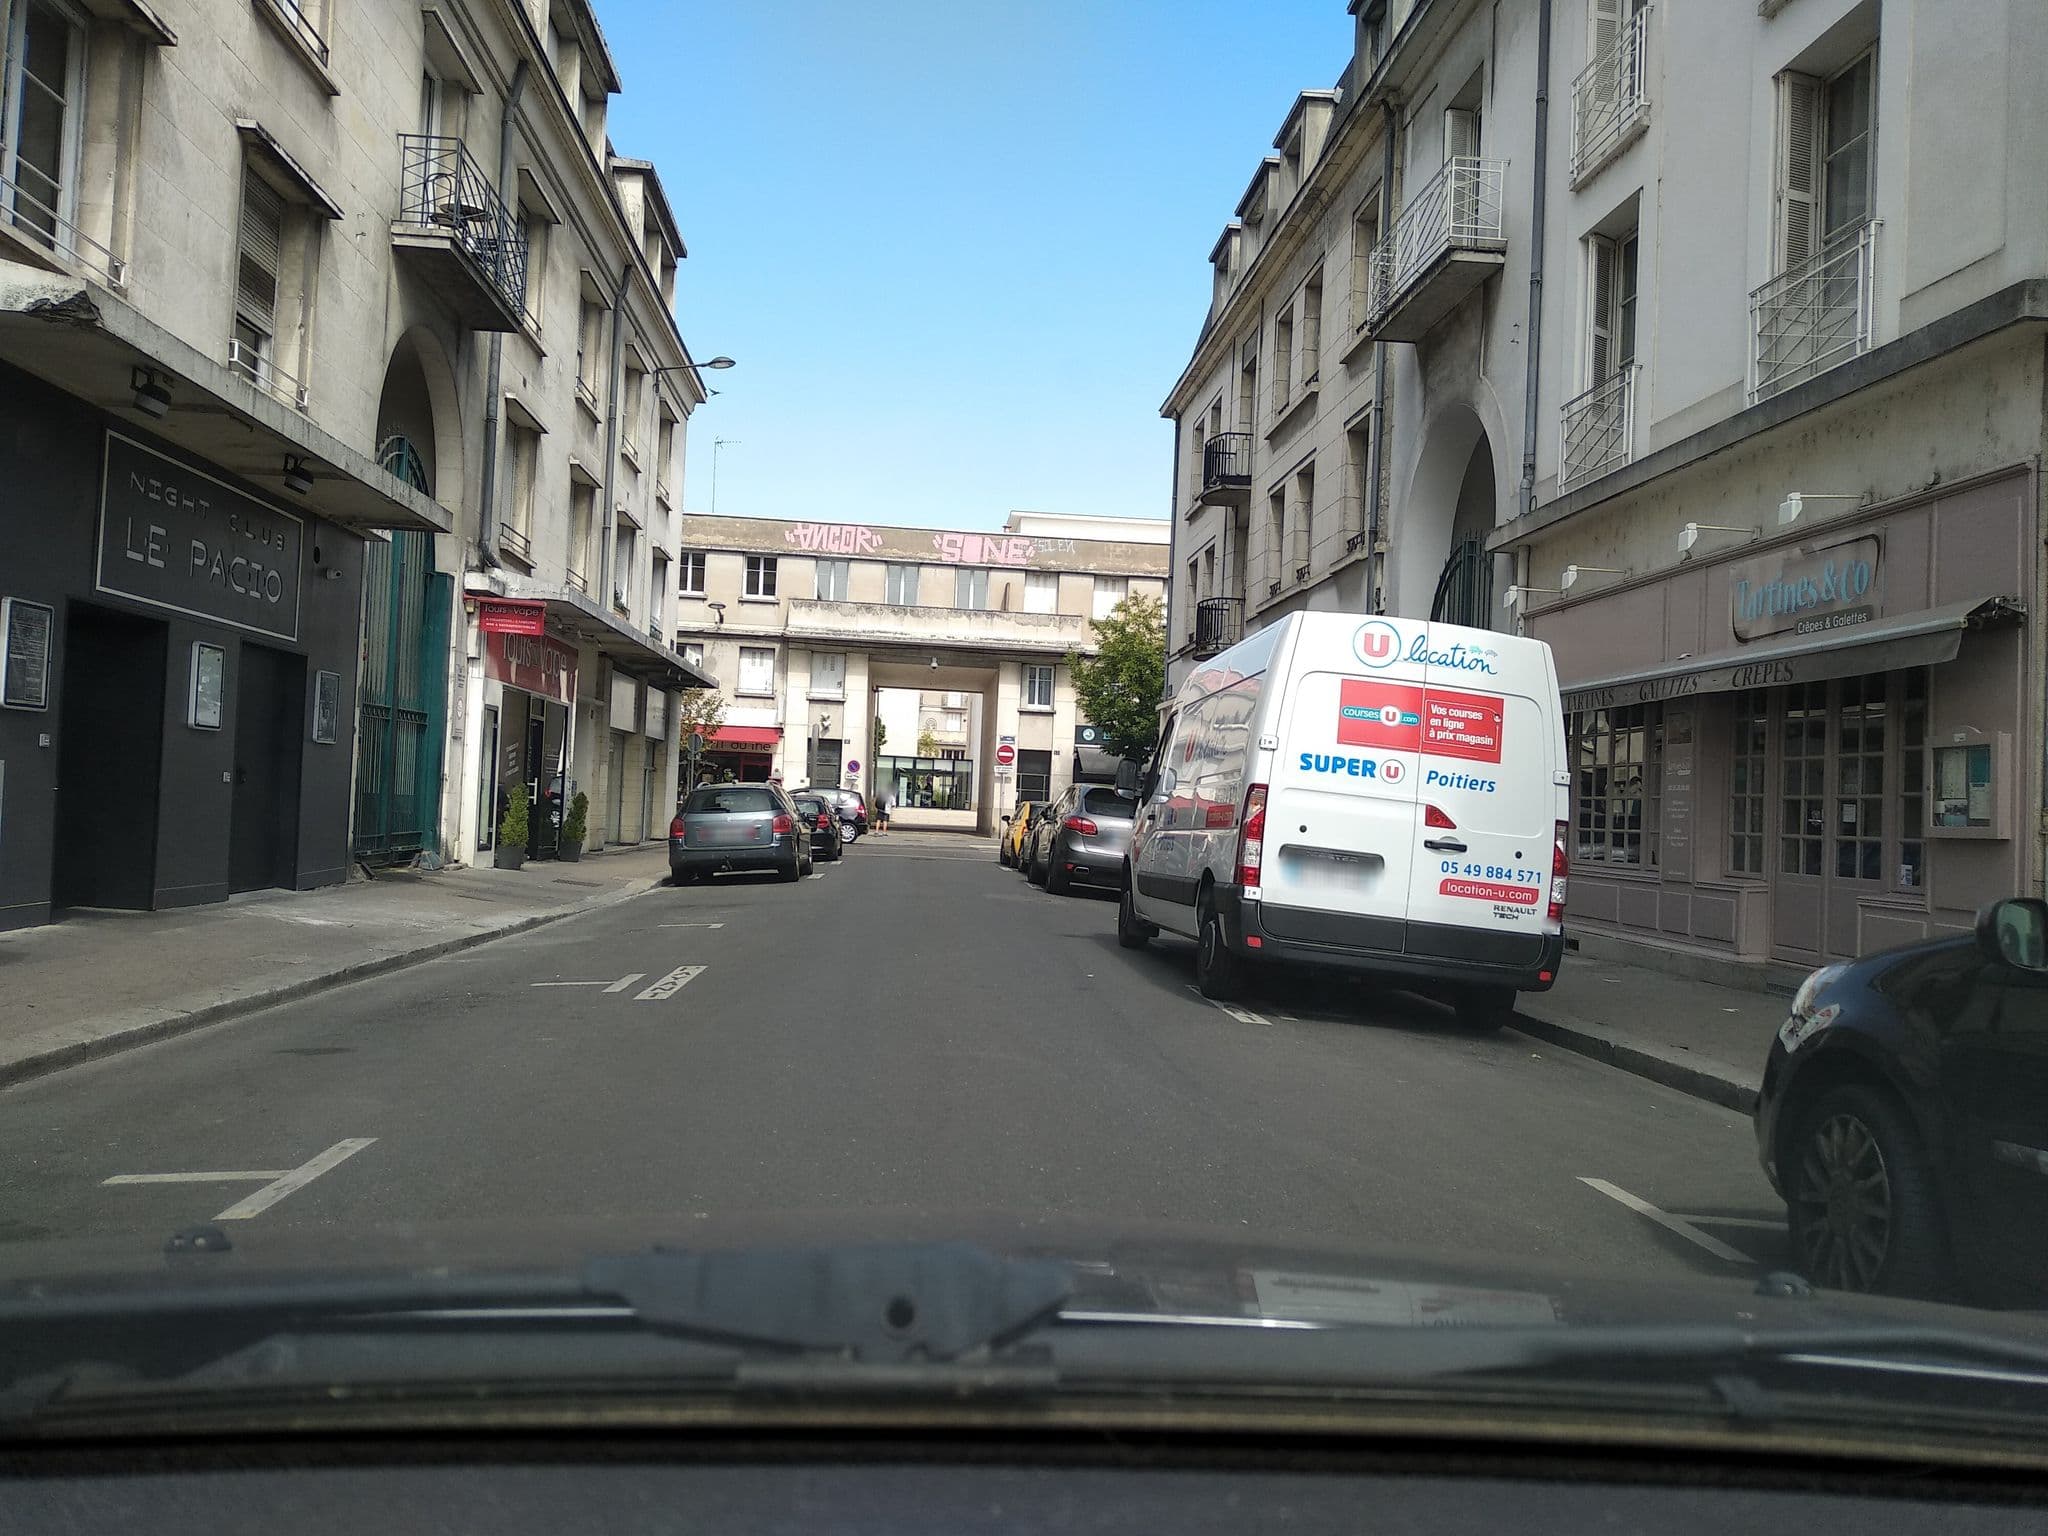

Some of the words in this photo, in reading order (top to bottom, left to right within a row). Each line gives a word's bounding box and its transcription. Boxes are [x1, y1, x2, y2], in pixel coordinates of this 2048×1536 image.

[130, 471, 210, 518] NIGHT
[229, 514, 285, 551] CLUB
[126, 516, 167, 568] LE
[190, 539, 283, 603] PACIO
[1797, 619, 1823, 634] Crêpes
[1825, 617, 1831, 629] &
[1833, 611, 1867, 627] Galettes
[1363, 632, 1390, 658] U
[1403, 634, 1498, 675] location
[1567, 687, 1616, 711] TARTINES
[1430, 703, 1447, 716] Vos
[1449, 707, 1483, 720] courses
[1430, 717, 1441, 727] en
[1443, 717, 1464, 730] ligne
[1429, 728, 1435, 738] à
[1437, 730, 1454, 742] prix
[1456, 733, 1494, 746] magasin
[1300, 753, 1376, 779] SUPER
[1385, 765, 1399, 779] U
[1426, 770, 1496, 793] Poitiers
[1441, 861, 1459, 874] 05
[1463, 864, 1481, 877] 49
[1486, 866, 1513, 881] 884
[1517, 870, 1541, 884] 571
[1447, 881, 1532, 901] location-u.com
[1493, 904, 1538, 915] RENAULT
[1493, 912, 1520, 921] TECH
